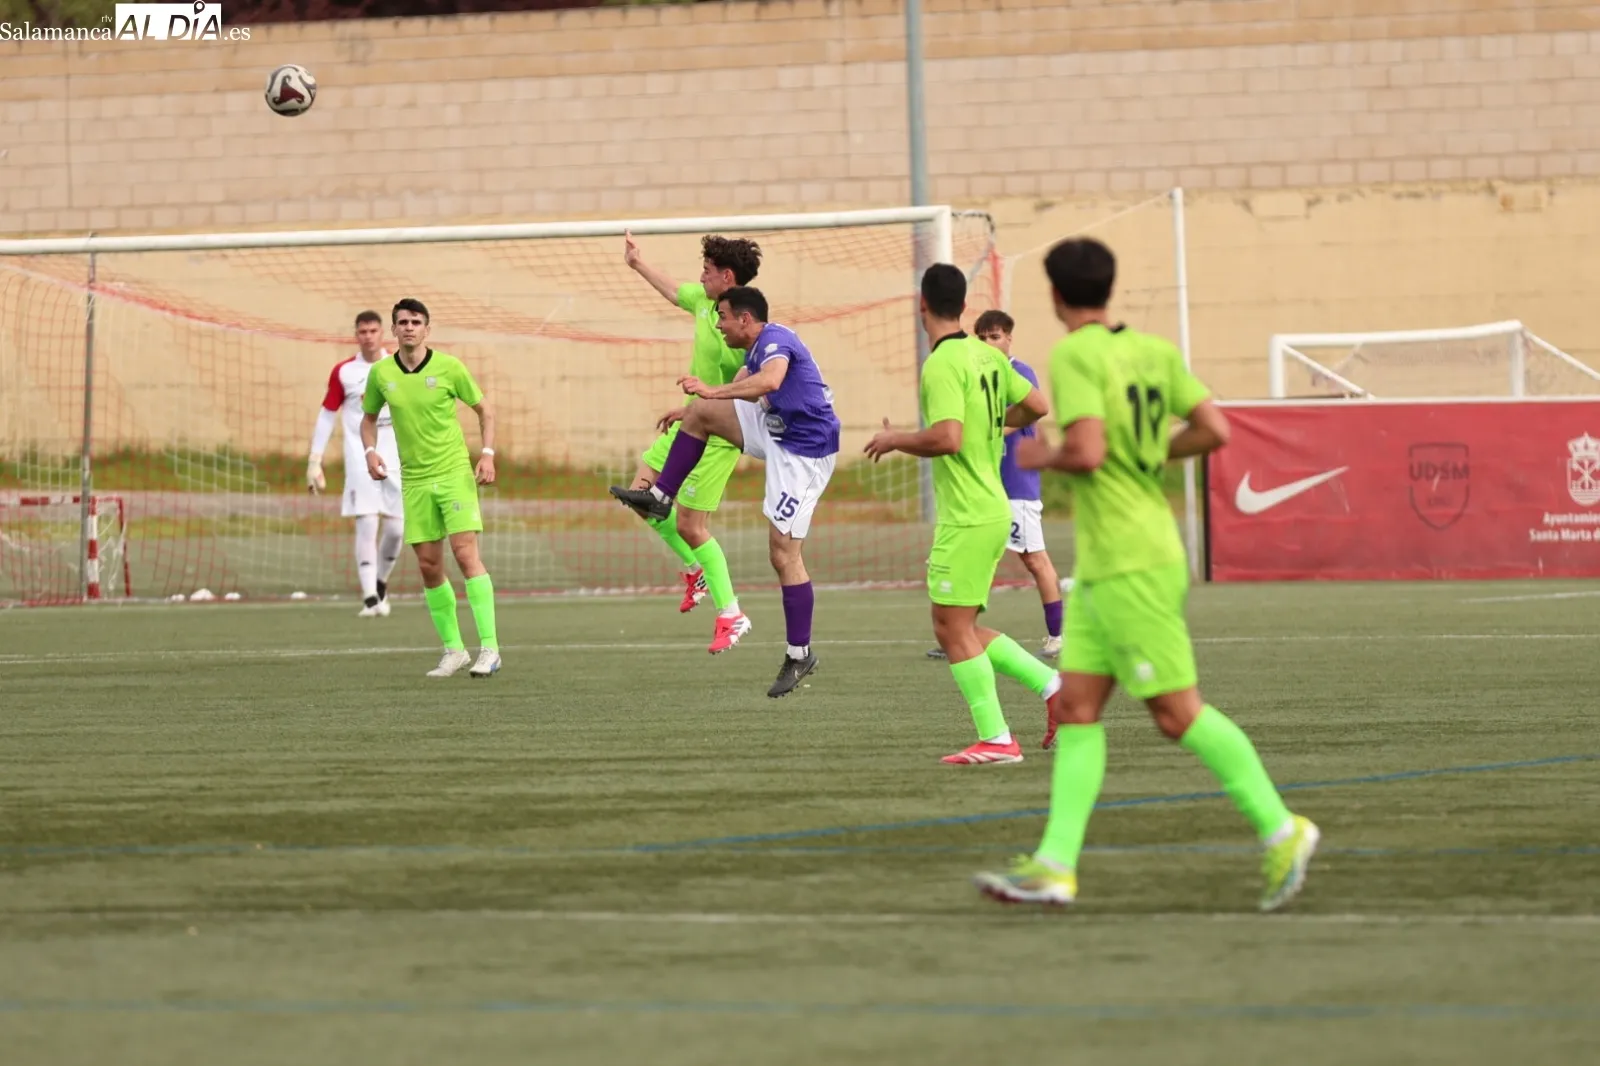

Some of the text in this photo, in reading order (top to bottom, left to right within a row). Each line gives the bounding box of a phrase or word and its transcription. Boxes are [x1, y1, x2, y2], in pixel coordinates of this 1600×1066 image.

[1408, 460, 1470, 481] UDSM
[775, 491, 800, 518] 15
[1529, 528, 1559, 542] Santa
[1560, 527, 1592, 542] Marta
